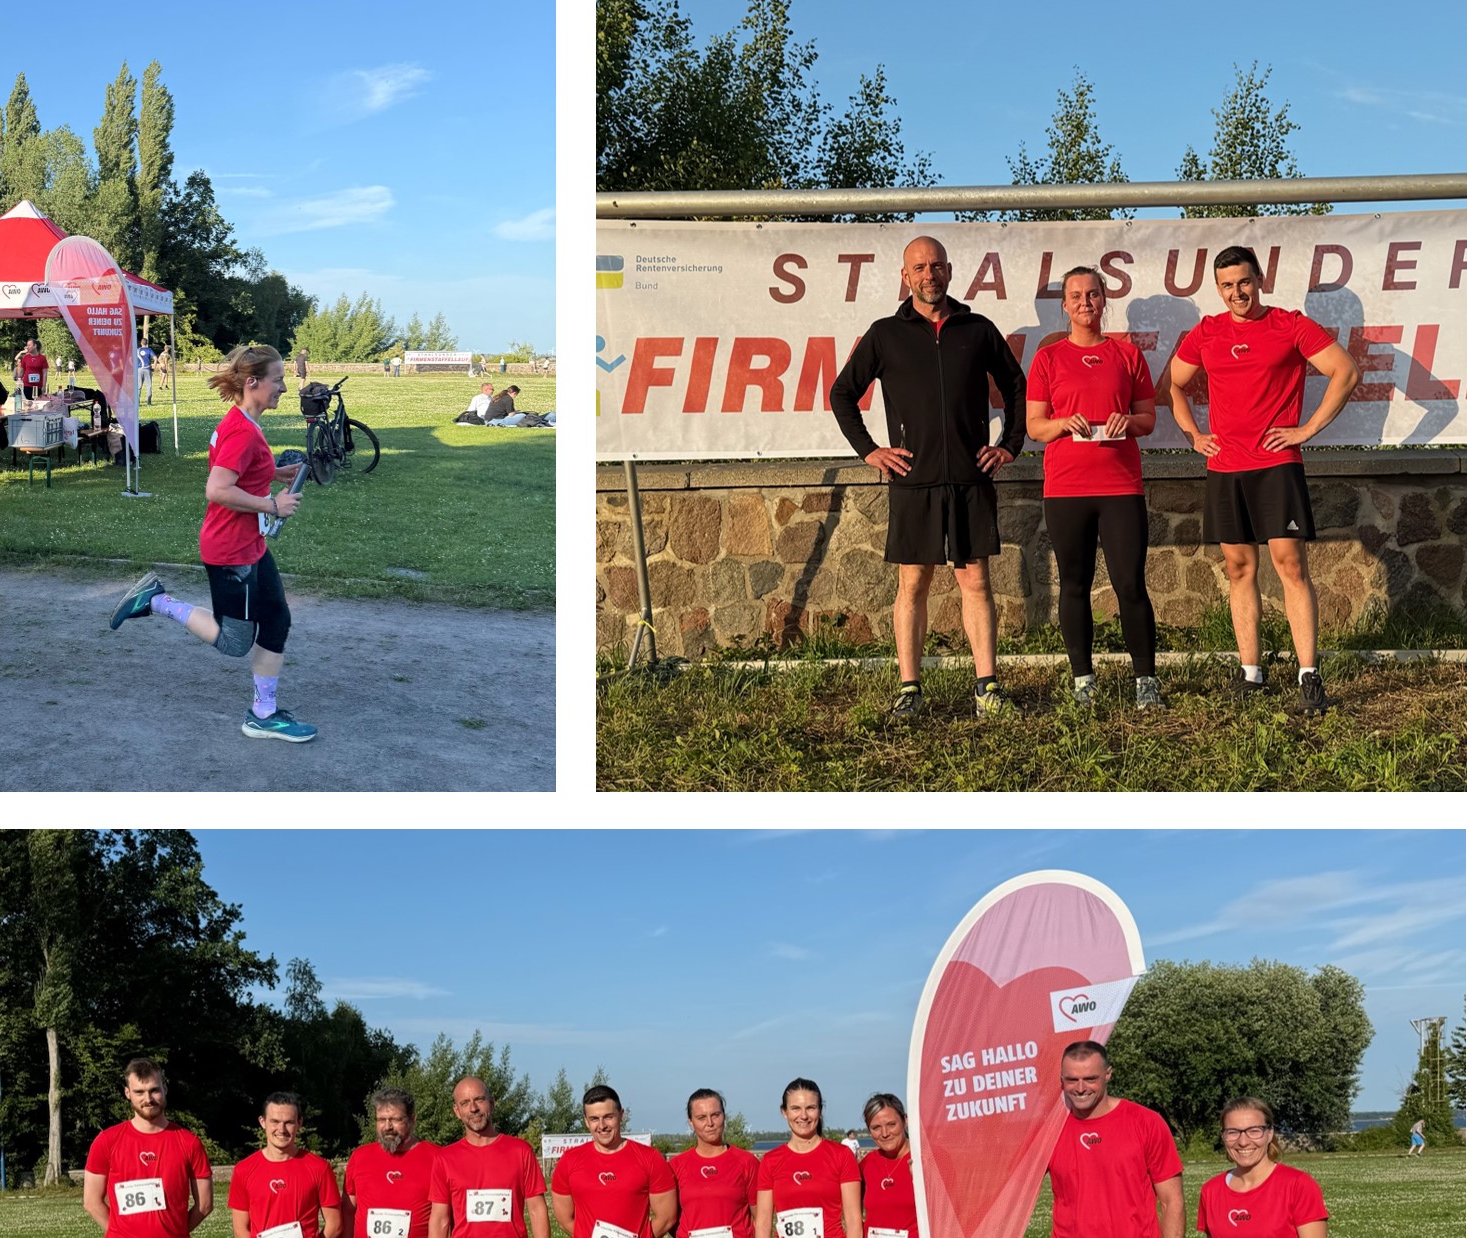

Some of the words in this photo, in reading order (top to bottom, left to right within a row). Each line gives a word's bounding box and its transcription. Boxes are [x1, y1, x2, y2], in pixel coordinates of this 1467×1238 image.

[636, 255, 677, 263] Deutsche
[636, 264, 723, 274] Rentenversicherung
[635, 281, 658, 290] Bund
[1071, 1001, 1097, 1015] AWO
[940, 1052, 976, 1074] SAG
[982, 1041, 1038, 1066] HALLO
[943, 1079, 966, 1098] ZU
[972, 1066, 1038, 1093] DEINER
[946, 1093, 1027, 1121] ZUKUNFT
[125, 1191, 146, 1208] 86
[474, 1201, 494, 1215] 87
[373, 1220, 392, 1234] 86
[398, 1228, 404, 1236] 2
[784, 1220, 804, 1236] 88
[813, 1227, 817, 1235] 1
